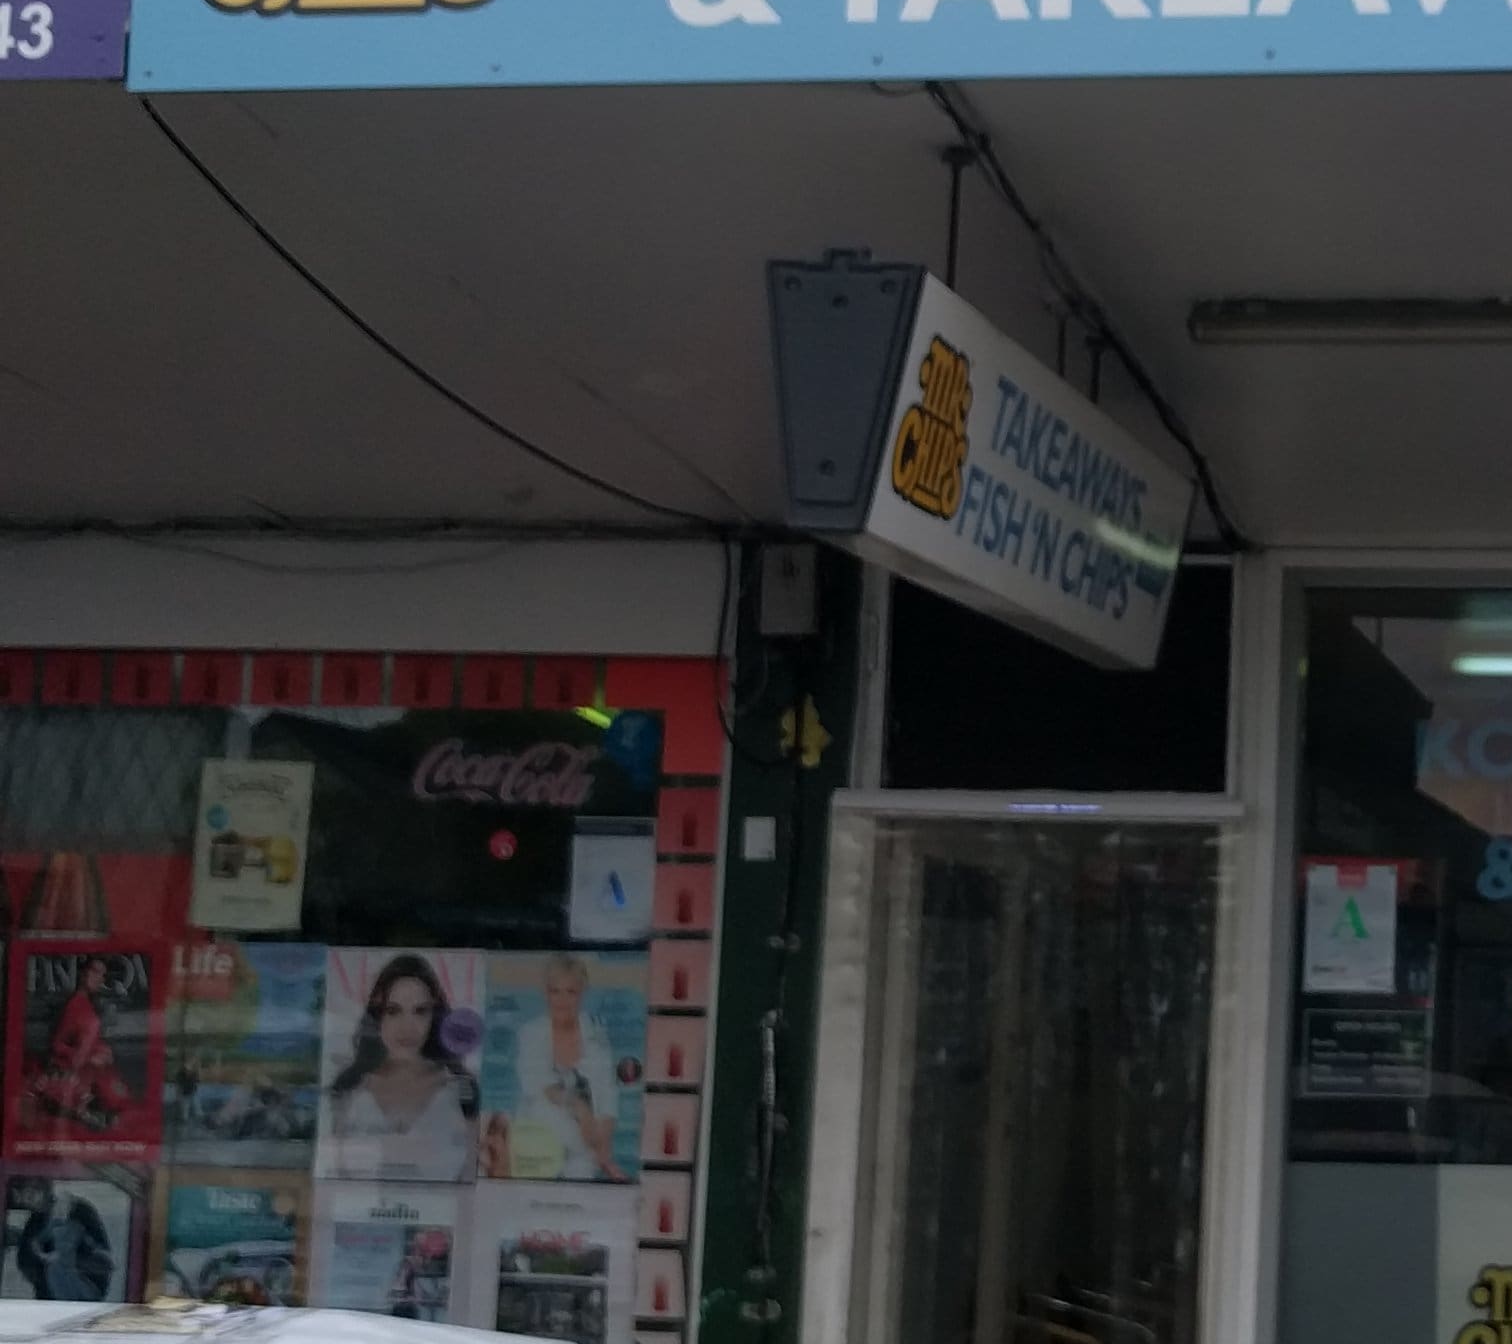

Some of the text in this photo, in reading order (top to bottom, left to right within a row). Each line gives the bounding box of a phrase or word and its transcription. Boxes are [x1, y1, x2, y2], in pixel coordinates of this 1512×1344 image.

[987, 374, 1149, 526] TAKEAWAYS
[955, 463, 1033, 567] FISH
[1060, 527, 1135, 621] CHIPS
